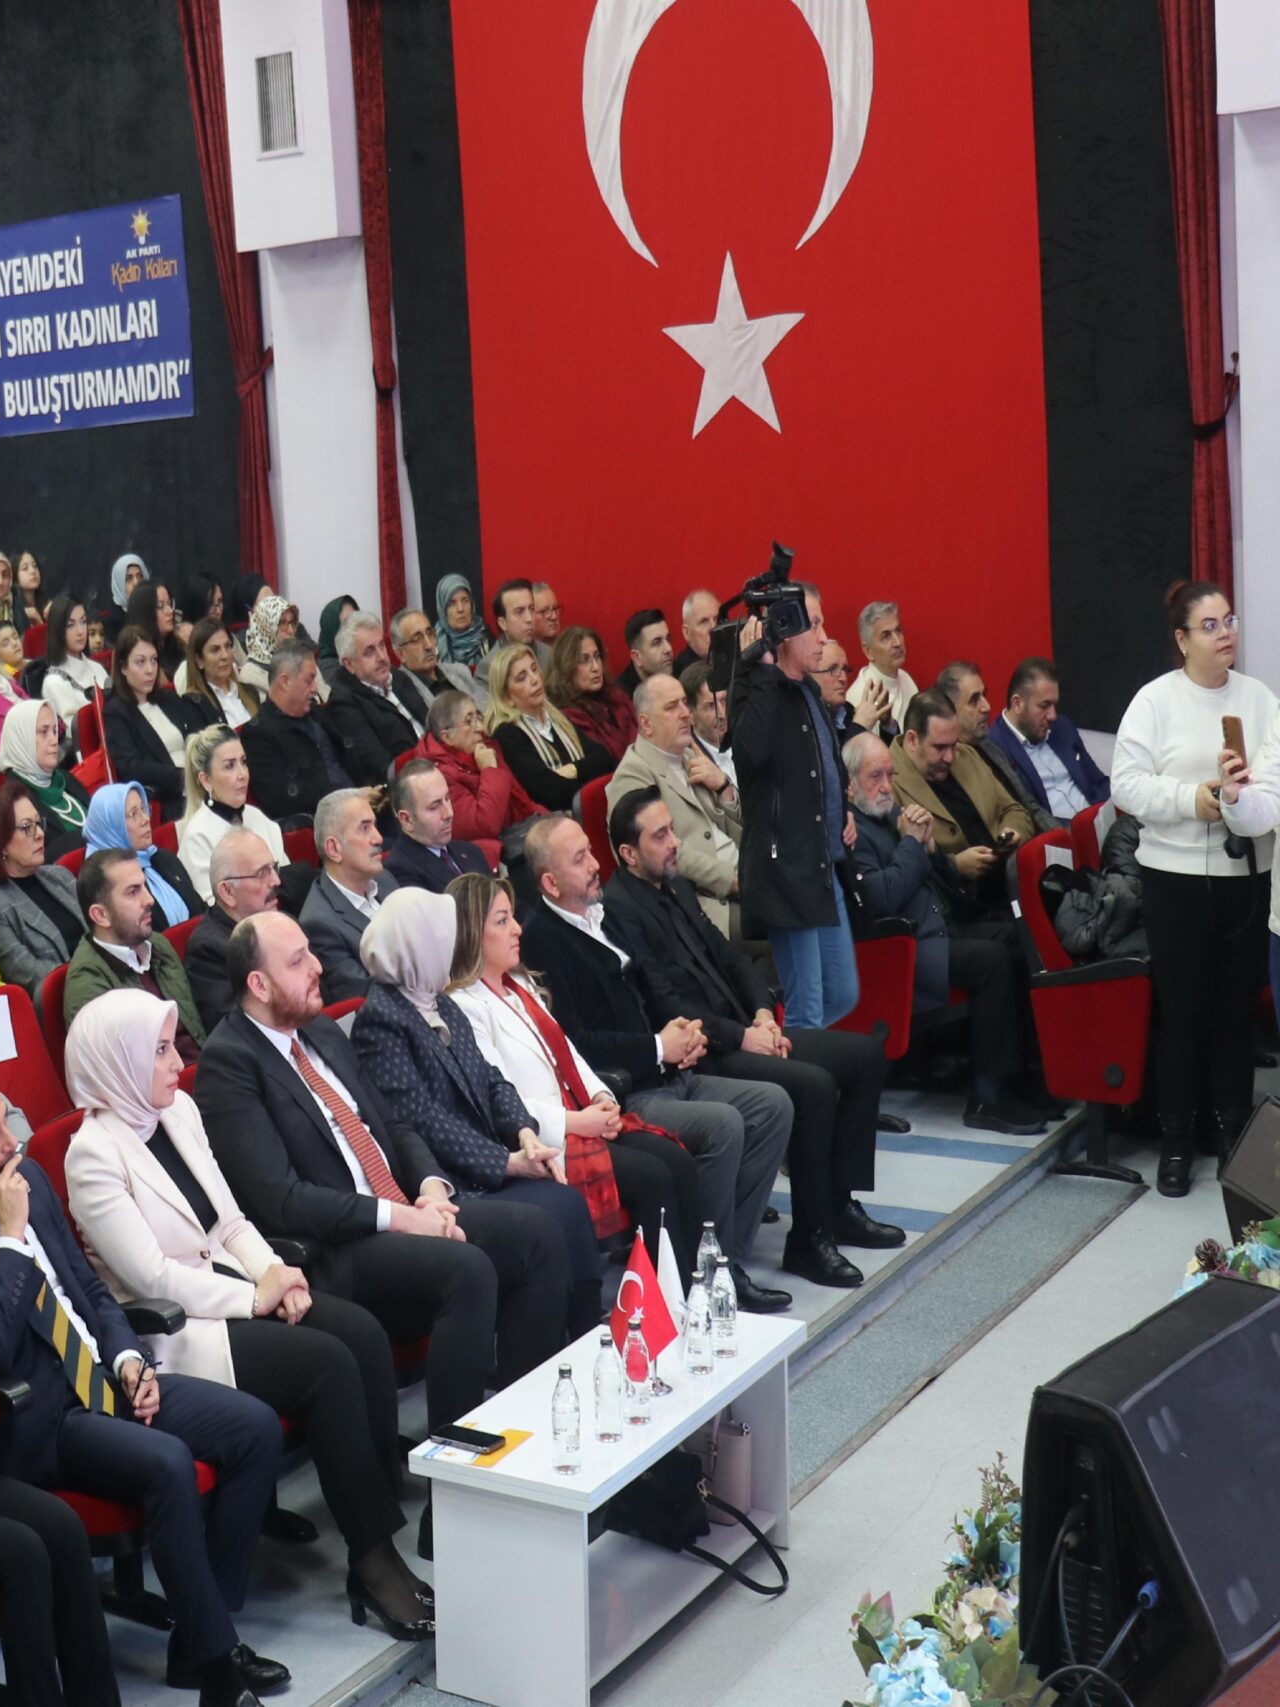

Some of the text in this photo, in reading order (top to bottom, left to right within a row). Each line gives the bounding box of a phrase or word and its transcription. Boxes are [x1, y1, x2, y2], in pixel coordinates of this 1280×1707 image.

[126, 245, 161, 259] AK PARTİ
[6, 317, 52, 356] SIRRI
[56, 299, 159, 350] KADINLARI
